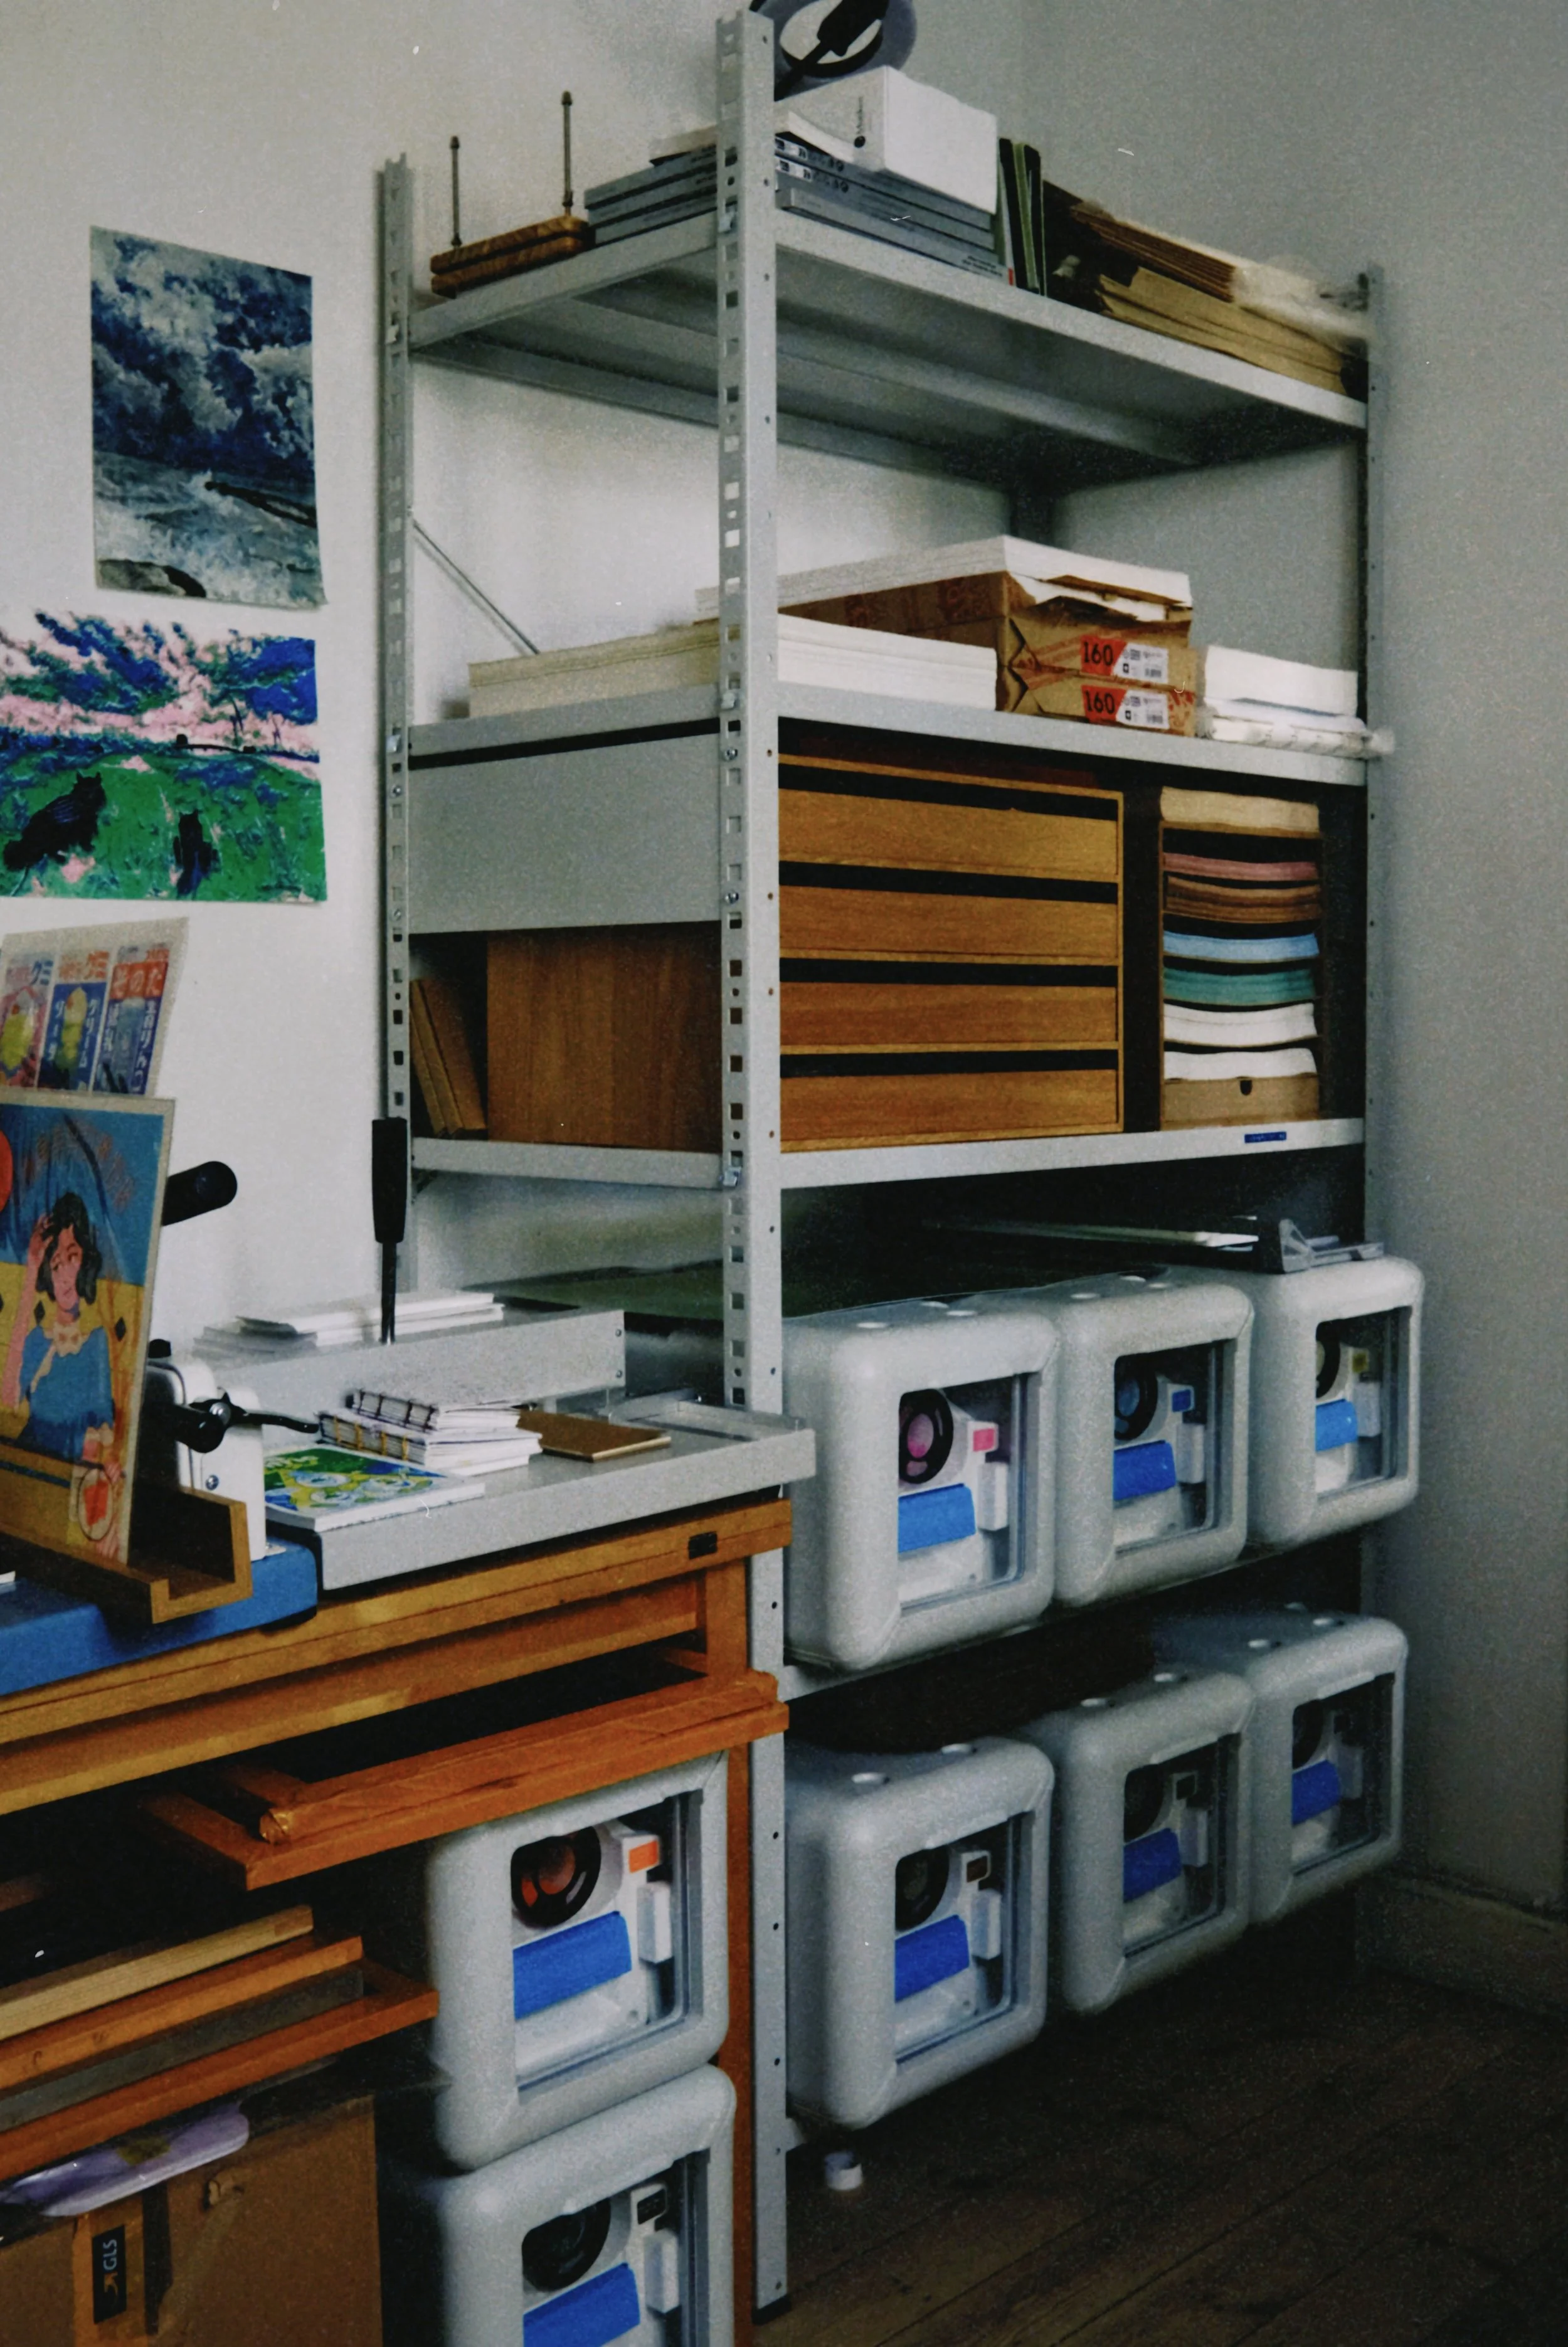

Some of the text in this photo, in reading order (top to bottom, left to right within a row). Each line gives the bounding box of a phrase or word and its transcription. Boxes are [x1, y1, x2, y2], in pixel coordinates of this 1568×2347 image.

[1083, 641, 1114, 666] 160
[1085, 690, 1115, 714] 160
[102, 2239, 118, 2270] GLS
